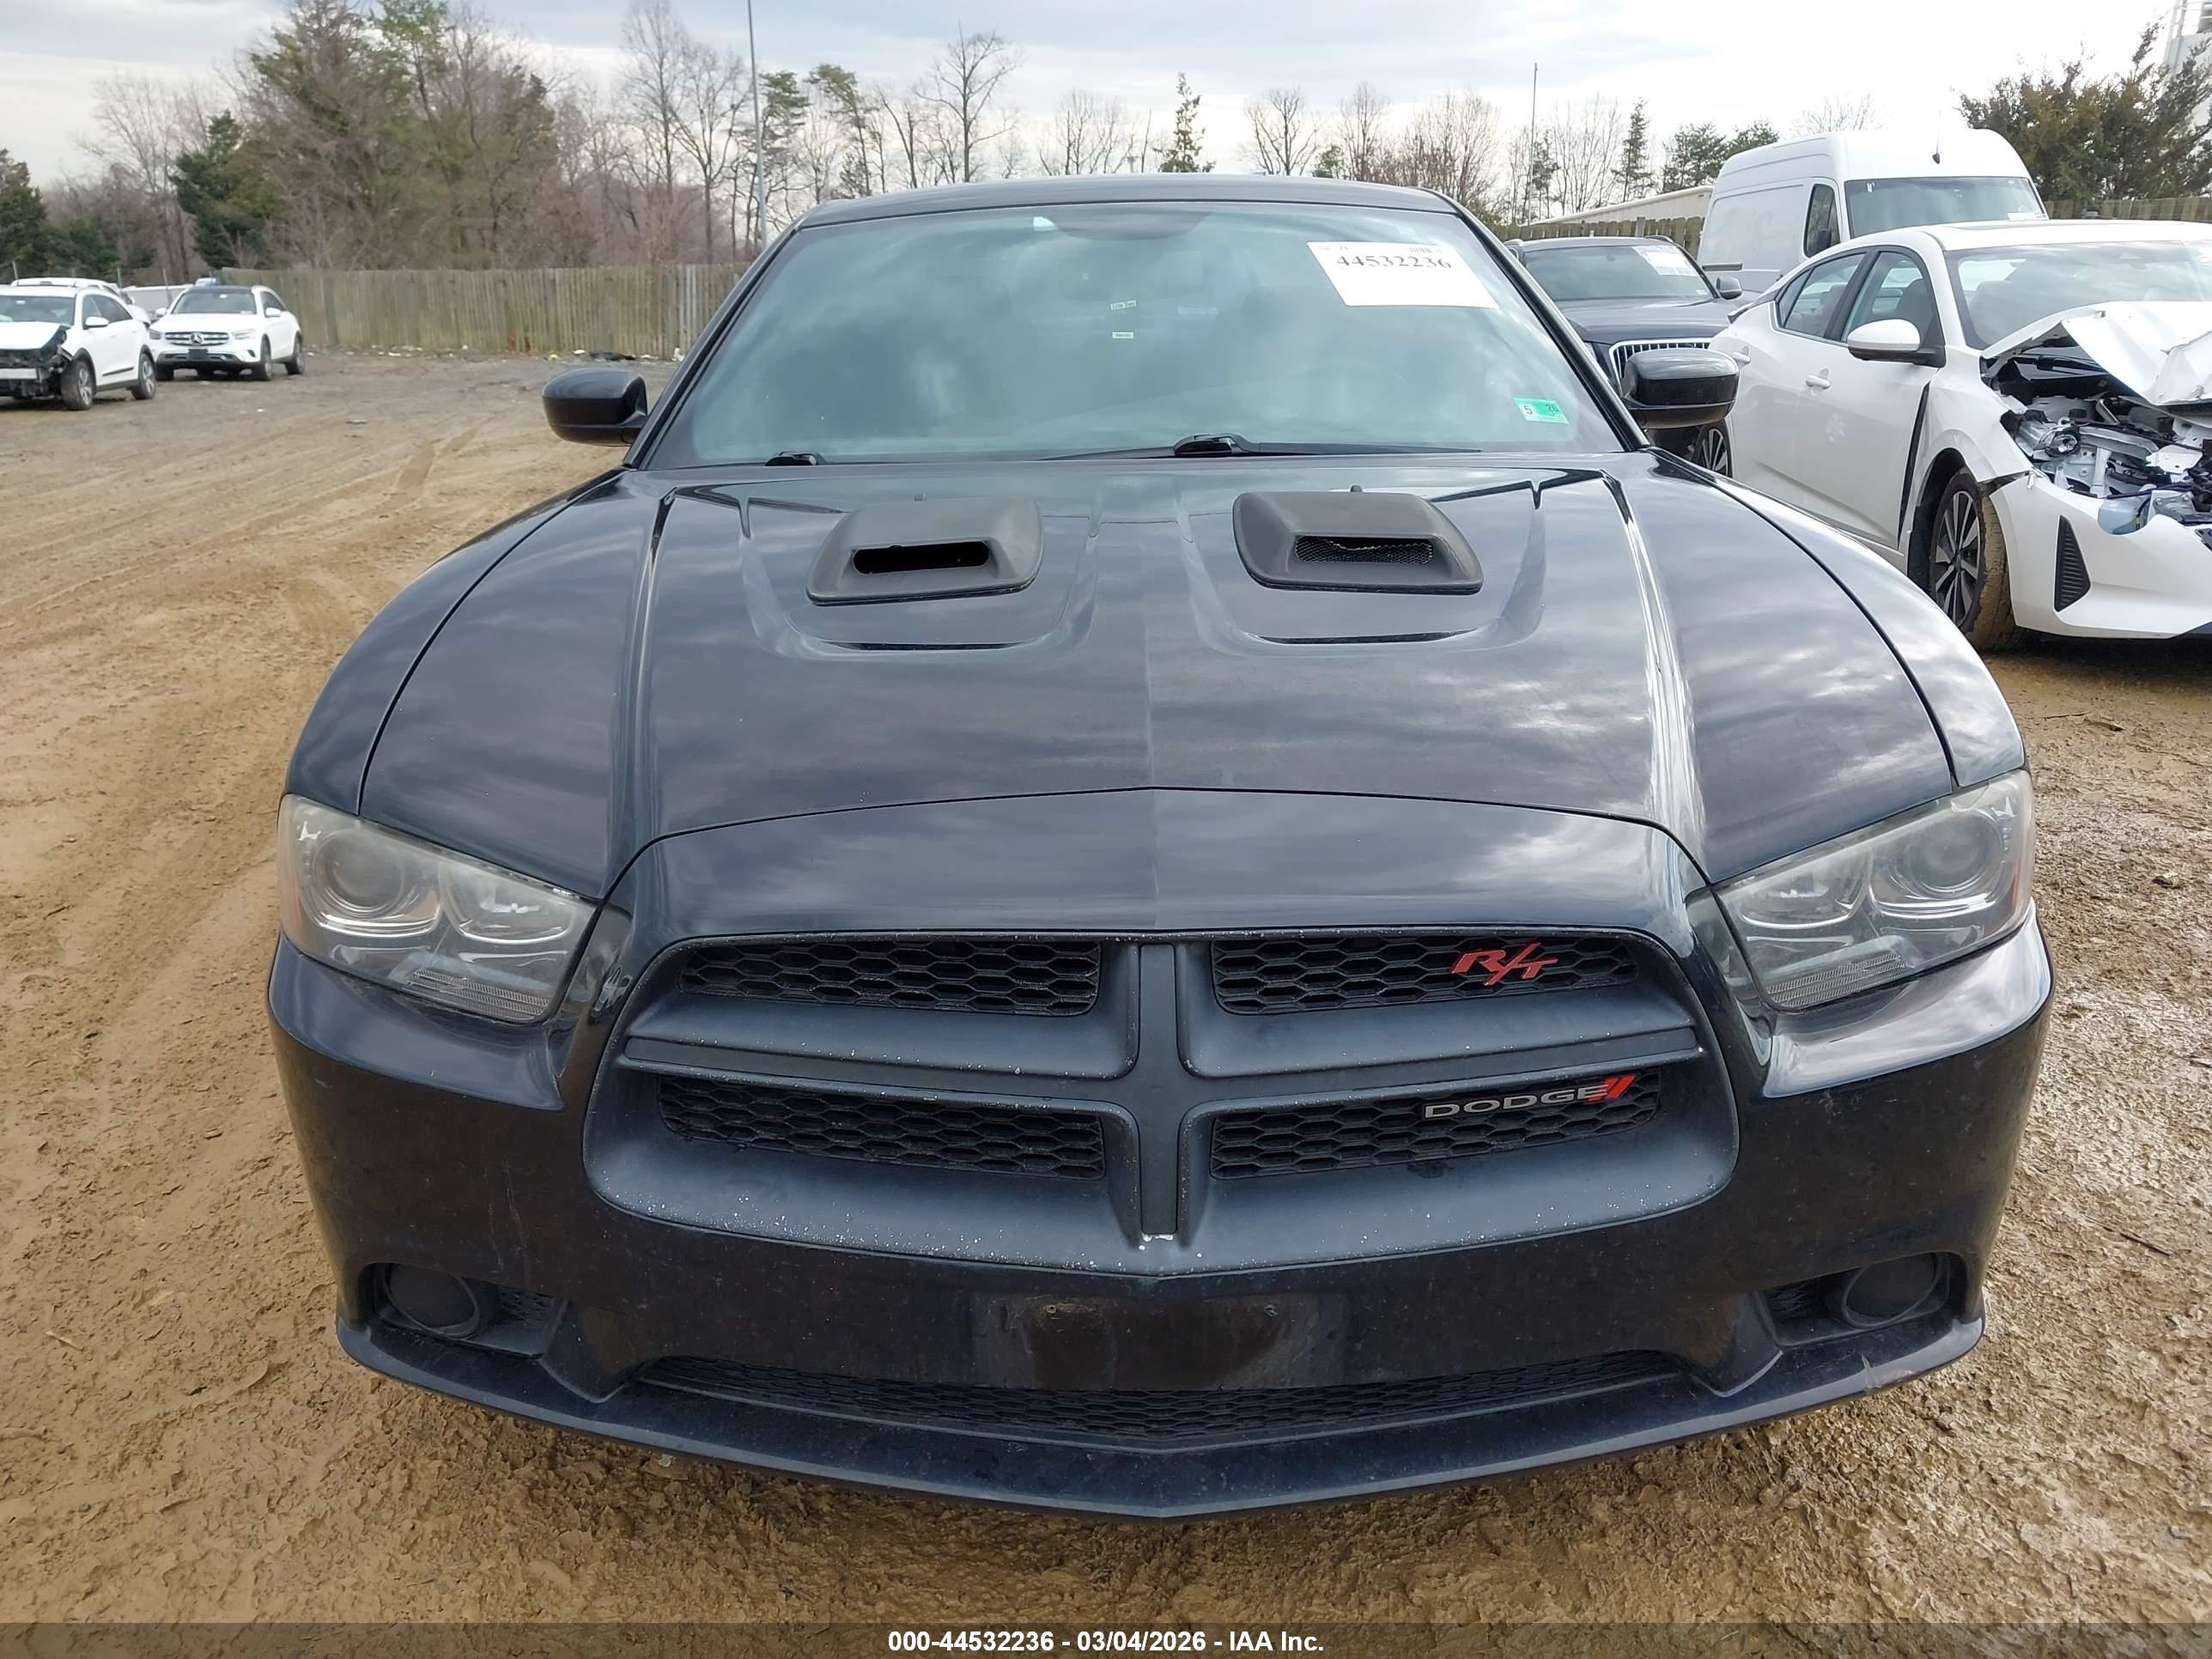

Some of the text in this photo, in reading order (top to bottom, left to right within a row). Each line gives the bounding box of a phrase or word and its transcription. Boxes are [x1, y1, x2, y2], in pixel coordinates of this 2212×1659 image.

[1337, 254, 1452, 269] 44532236
[1450, 941, 1559, 986] R/T
[1424, 1083, 1610, 1119] DODGE
